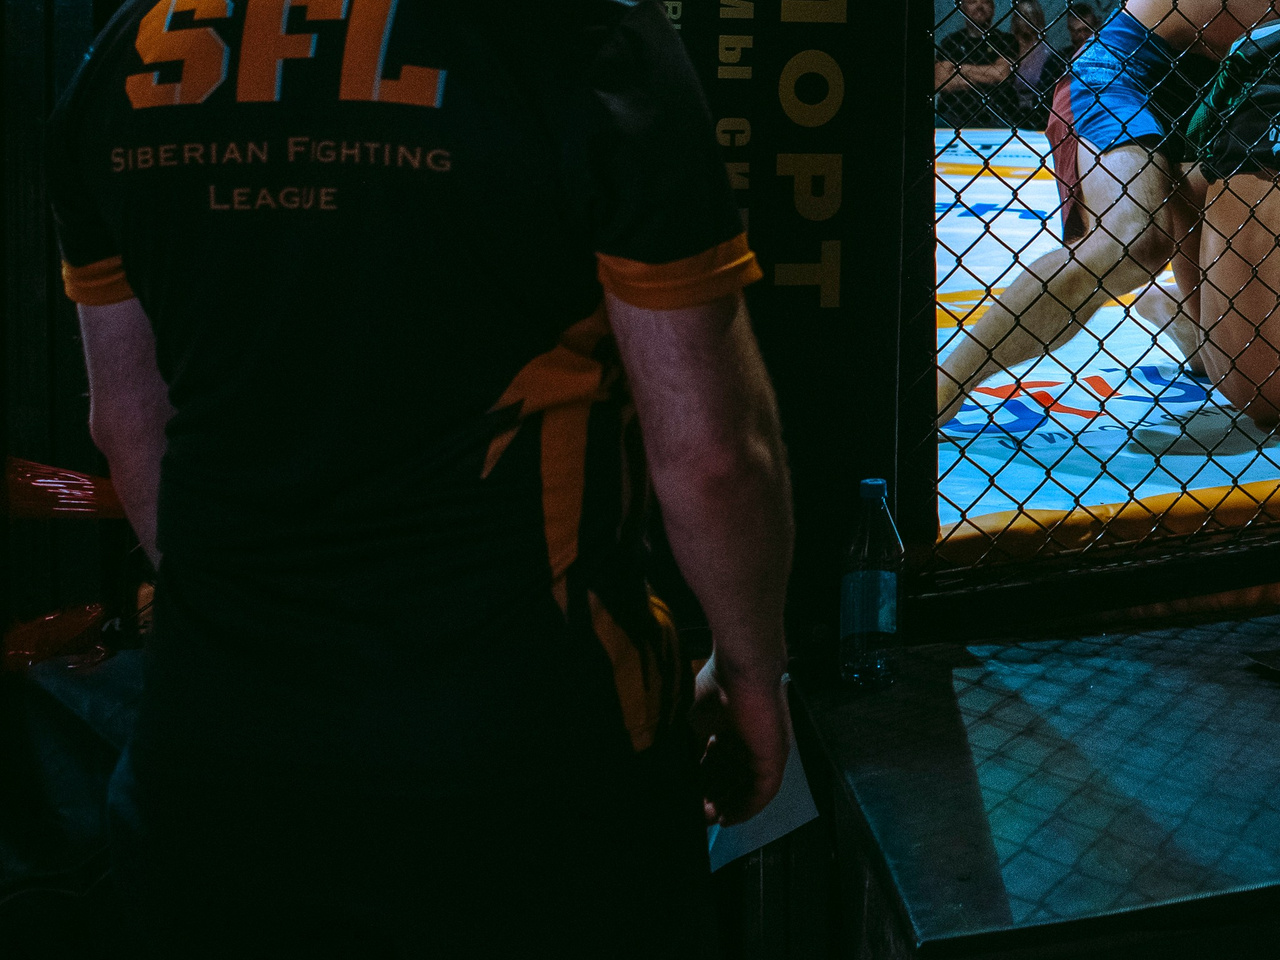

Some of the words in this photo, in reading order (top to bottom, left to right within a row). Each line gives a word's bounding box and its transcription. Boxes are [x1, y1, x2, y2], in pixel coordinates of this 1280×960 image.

[110, 142, 269, 173] SIBERIAN
[287, 137, 452, 172] FIGHTING
[208, 185, 339, 211] LEAGUE
